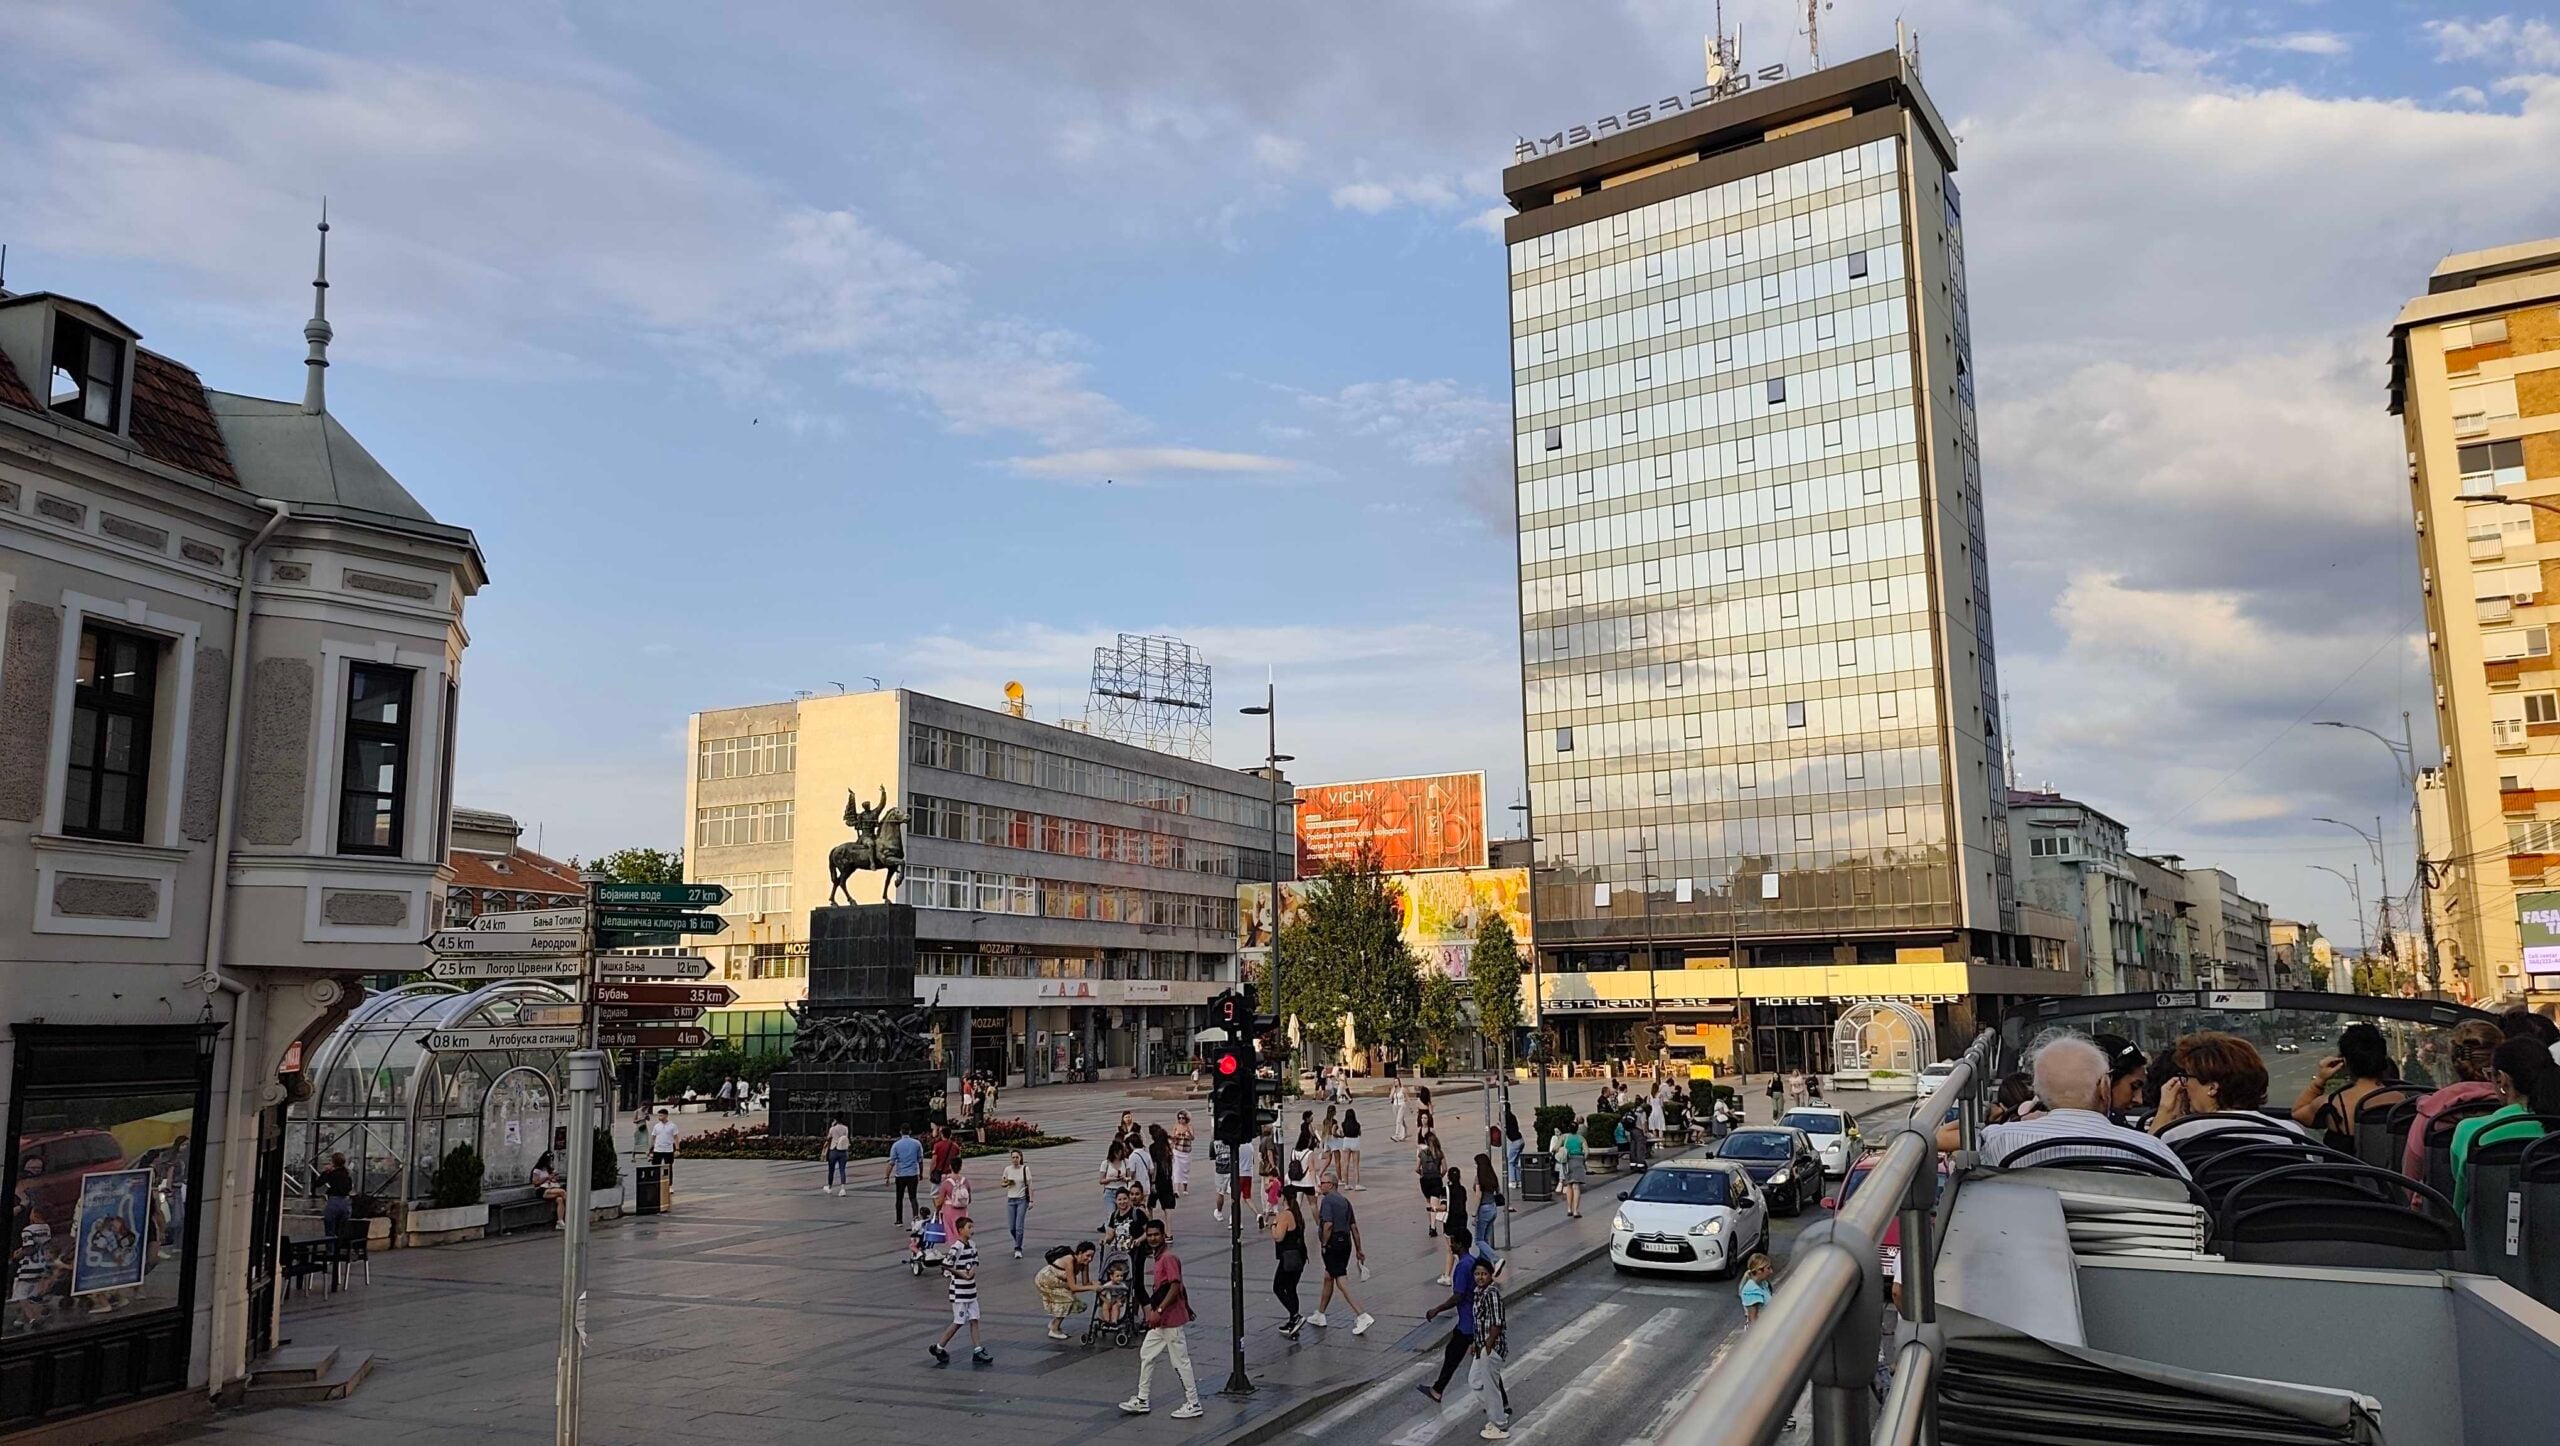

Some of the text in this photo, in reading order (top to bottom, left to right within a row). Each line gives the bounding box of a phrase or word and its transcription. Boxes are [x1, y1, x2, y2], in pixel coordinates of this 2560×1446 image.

[1515, 63, 1784, 156] AMBASADOR
[1328, 789, 1375, 804] VICHY
[600, 888, 717, 902] Бојанине воде 27 km
[480, 914, 582, 931] 24 km Бања Топило
[602, 914, 714, 929] Јелашничка клисура 16 km
[438, 936, 577, 951] 4.5 km Аеродром
[979, 943, 1016, 955] MOZZART
[439, 961, 578, 976] 2.5 km Логор Црвени Крст
[624, 960, 645, 972] Бања
[677, 962, 685, 974] 12
[686, 961, 700, 974] km
[598, 987, 722, 1003] Бубањ 3.5 km
[1756, 994, 1960, 1006] HOTEL AMBASADOR
[681, 1006, 693, 1016] km
[1224, 1002, 1234, 1021] 9
[1540, 998, 1711, 1010] RESTAURANT BAR
[971, 1018, 1005, 1029] MOZZART
[433, 1033, 576, 1048] 0.8 km Аутобуска станица
[616, 1031, 636, 1046] Кула
[677, 1033, 684, 1044] 4
[685, 1032, 698, 1044] km
